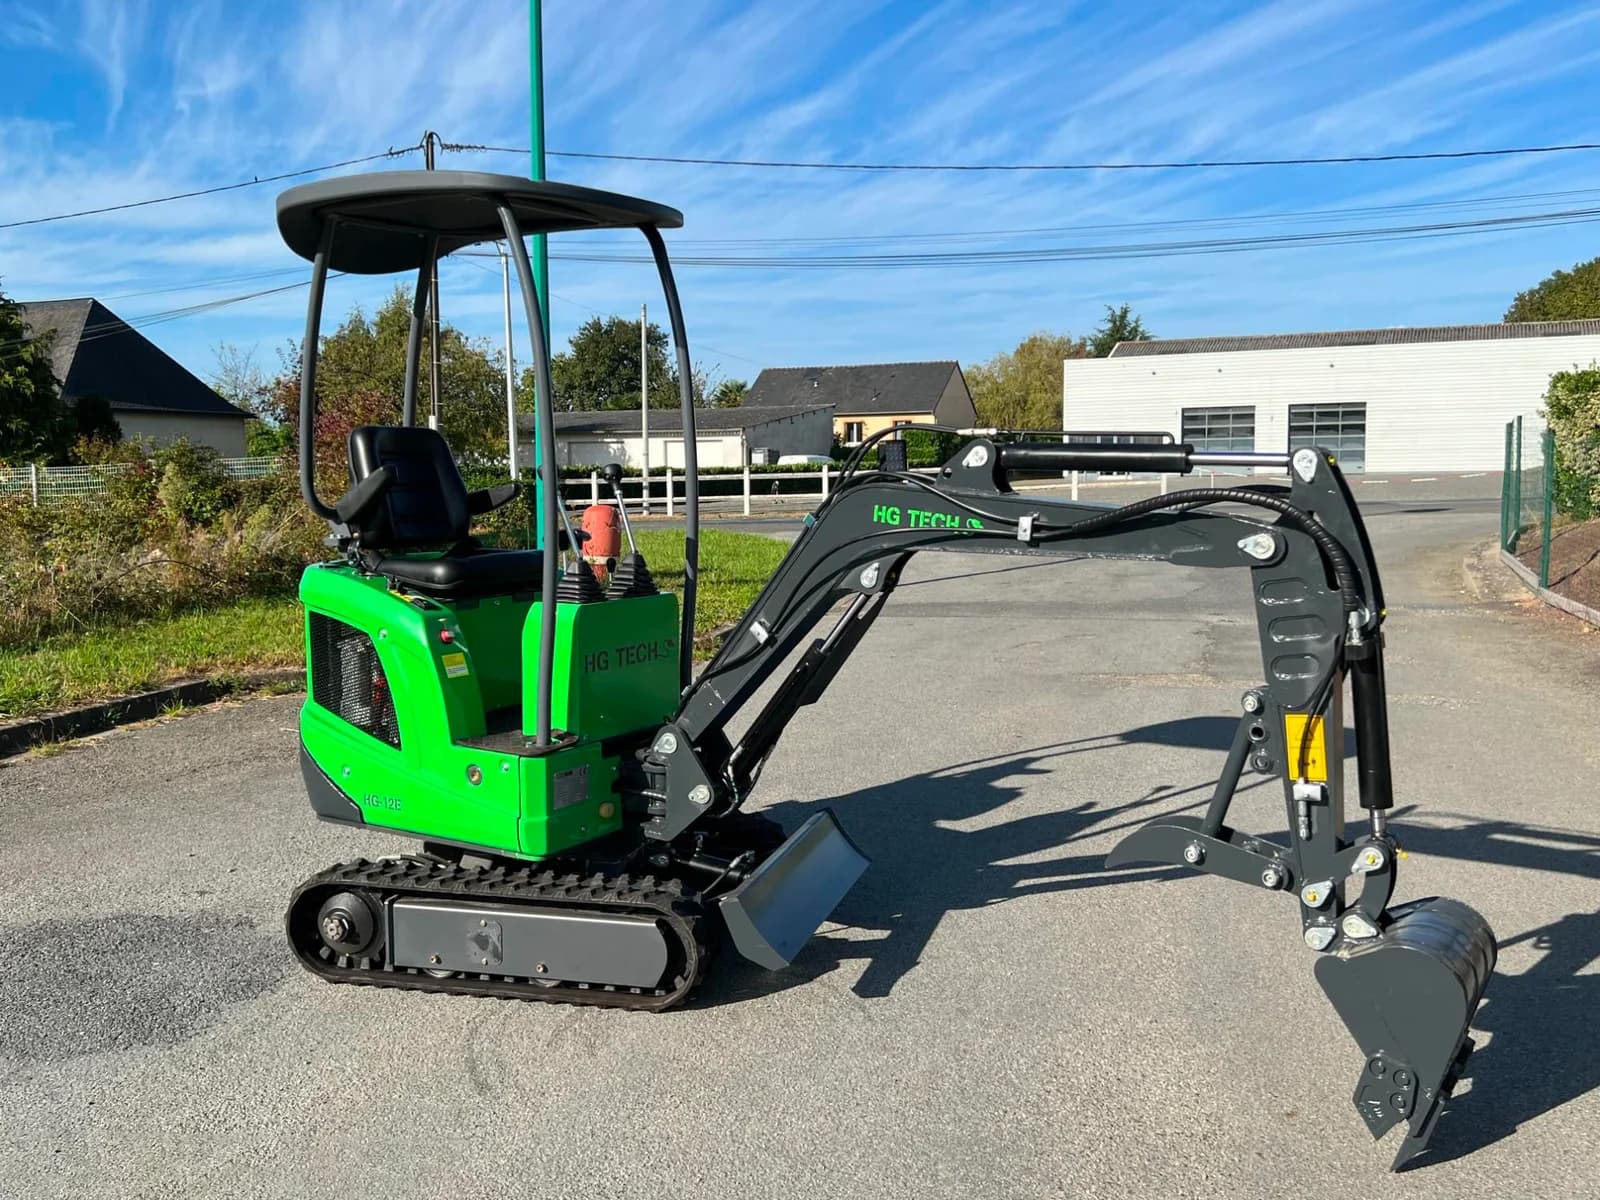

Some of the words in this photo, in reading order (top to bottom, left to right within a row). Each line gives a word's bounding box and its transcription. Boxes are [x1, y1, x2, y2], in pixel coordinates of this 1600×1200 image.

[873, 504, 900, 526] HG
[907, 509, 960, 529] TECH
[584, 651, 609, 674] HG
[616, 641, 658, 668] TECH
